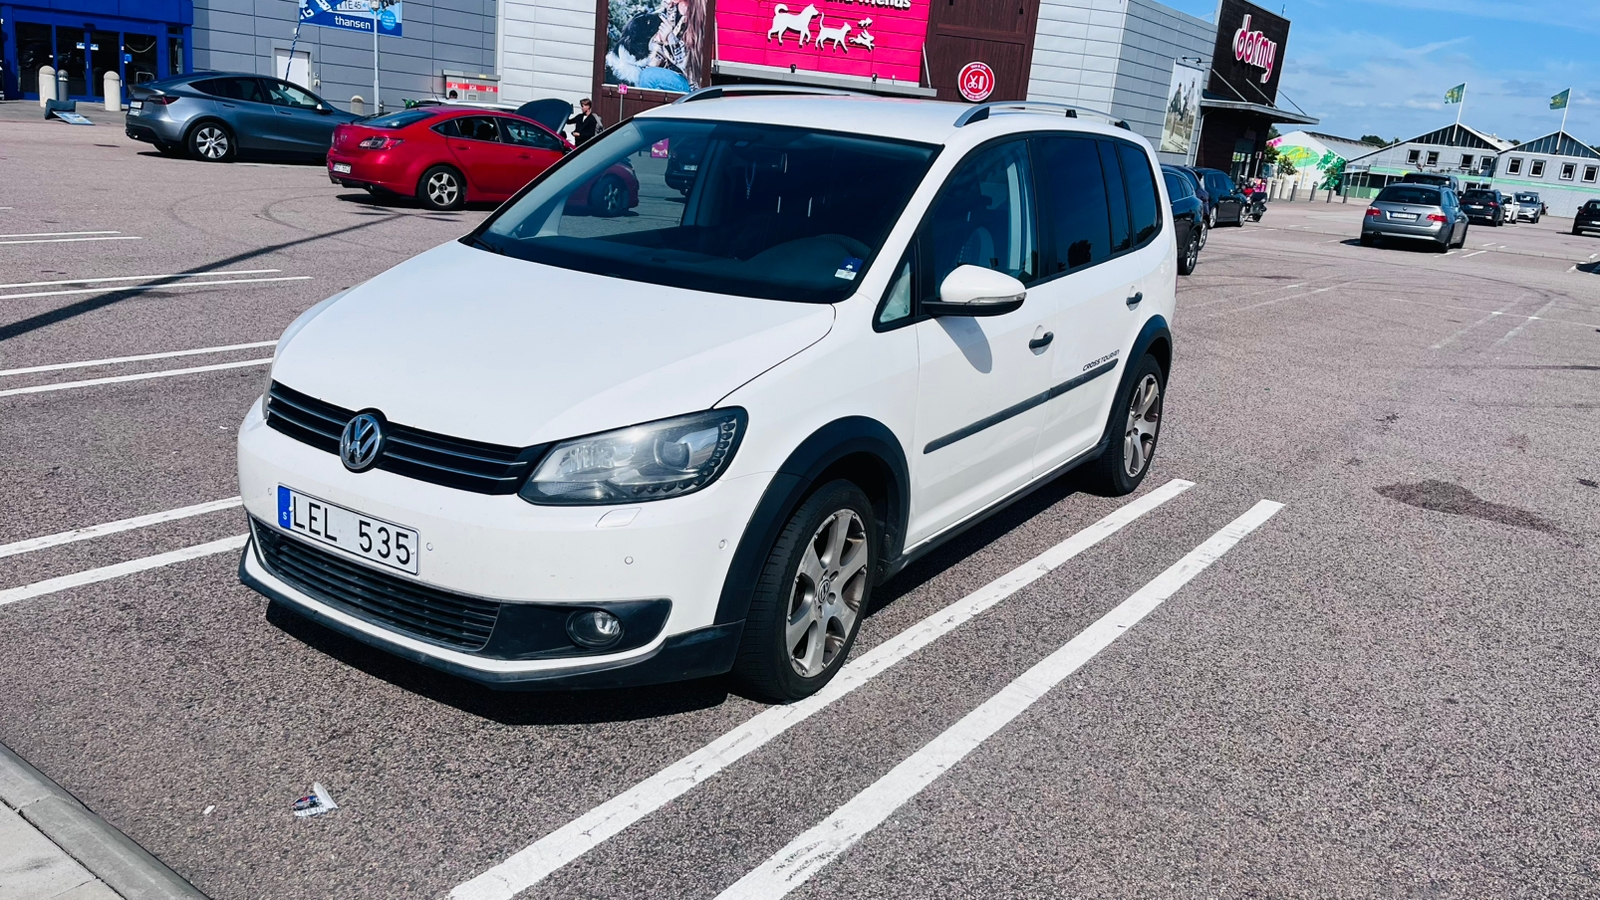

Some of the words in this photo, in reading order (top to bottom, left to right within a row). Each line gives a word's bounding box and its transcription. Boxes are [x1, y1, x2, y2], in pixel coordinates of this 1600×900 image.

[335, 15, 371, 30] thansen
[1232, 14, 1277, 83] dormy
[282, 511, 288, 521] S
[293, 495, 338, 543] LEL
[358, 519, 411, 566] 535
